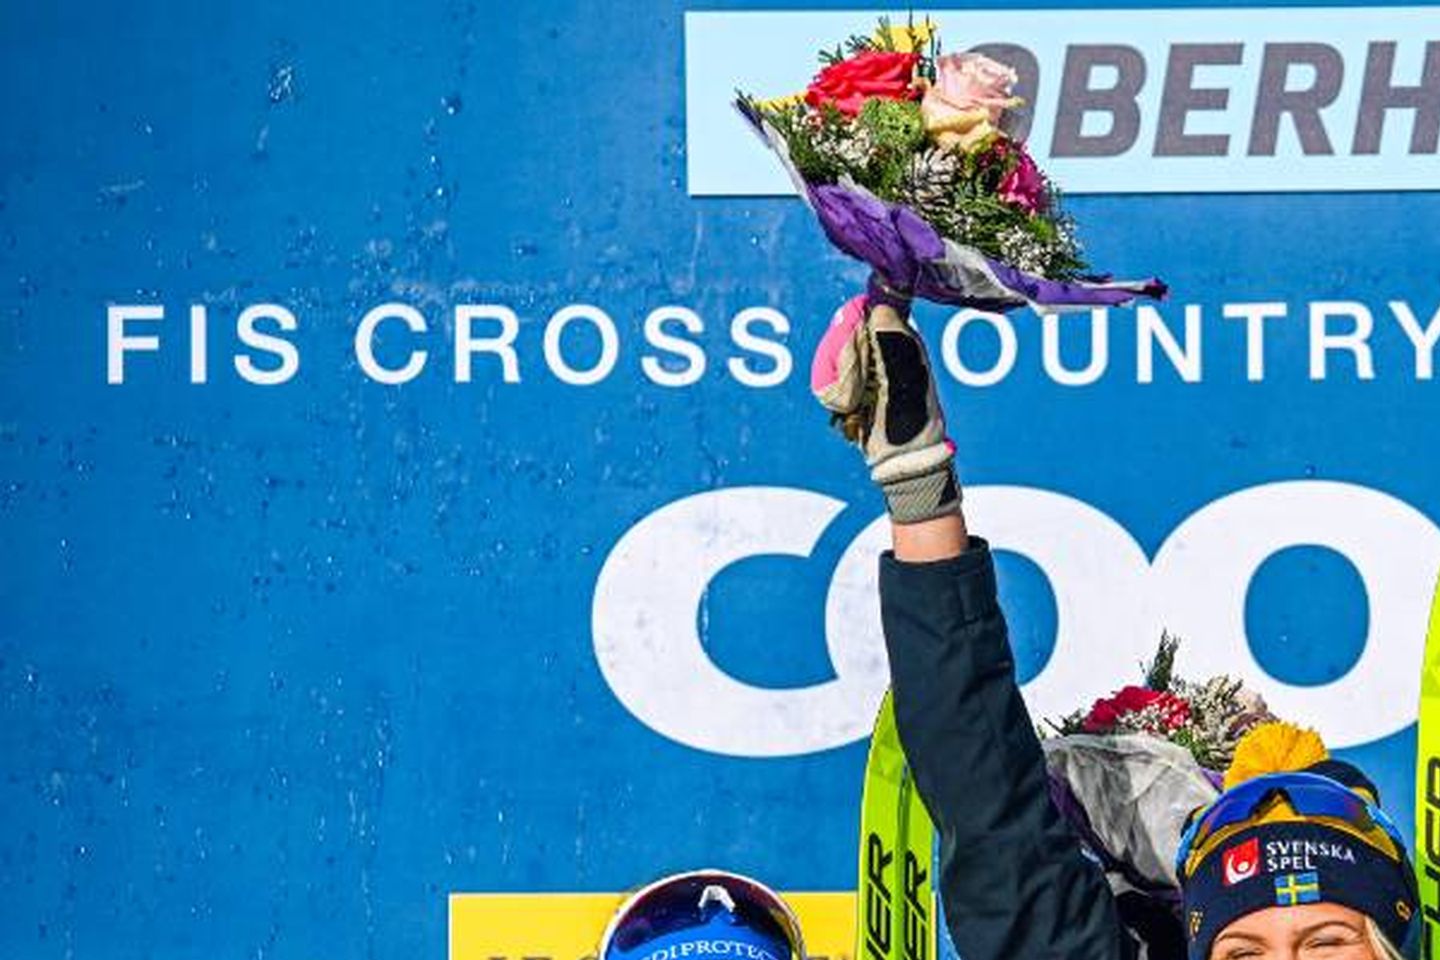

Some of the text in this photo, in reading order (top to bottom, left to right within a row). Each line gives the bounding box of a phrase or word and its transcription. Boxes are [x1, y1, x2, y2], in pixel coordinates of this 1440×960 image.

[107, 303, 302, 386] FIS
[354, 303, 792, 387] CROSS
[1266, 840, 1356, 864] SVENSKA
[1267, 855, 1317, 872] SPEL
